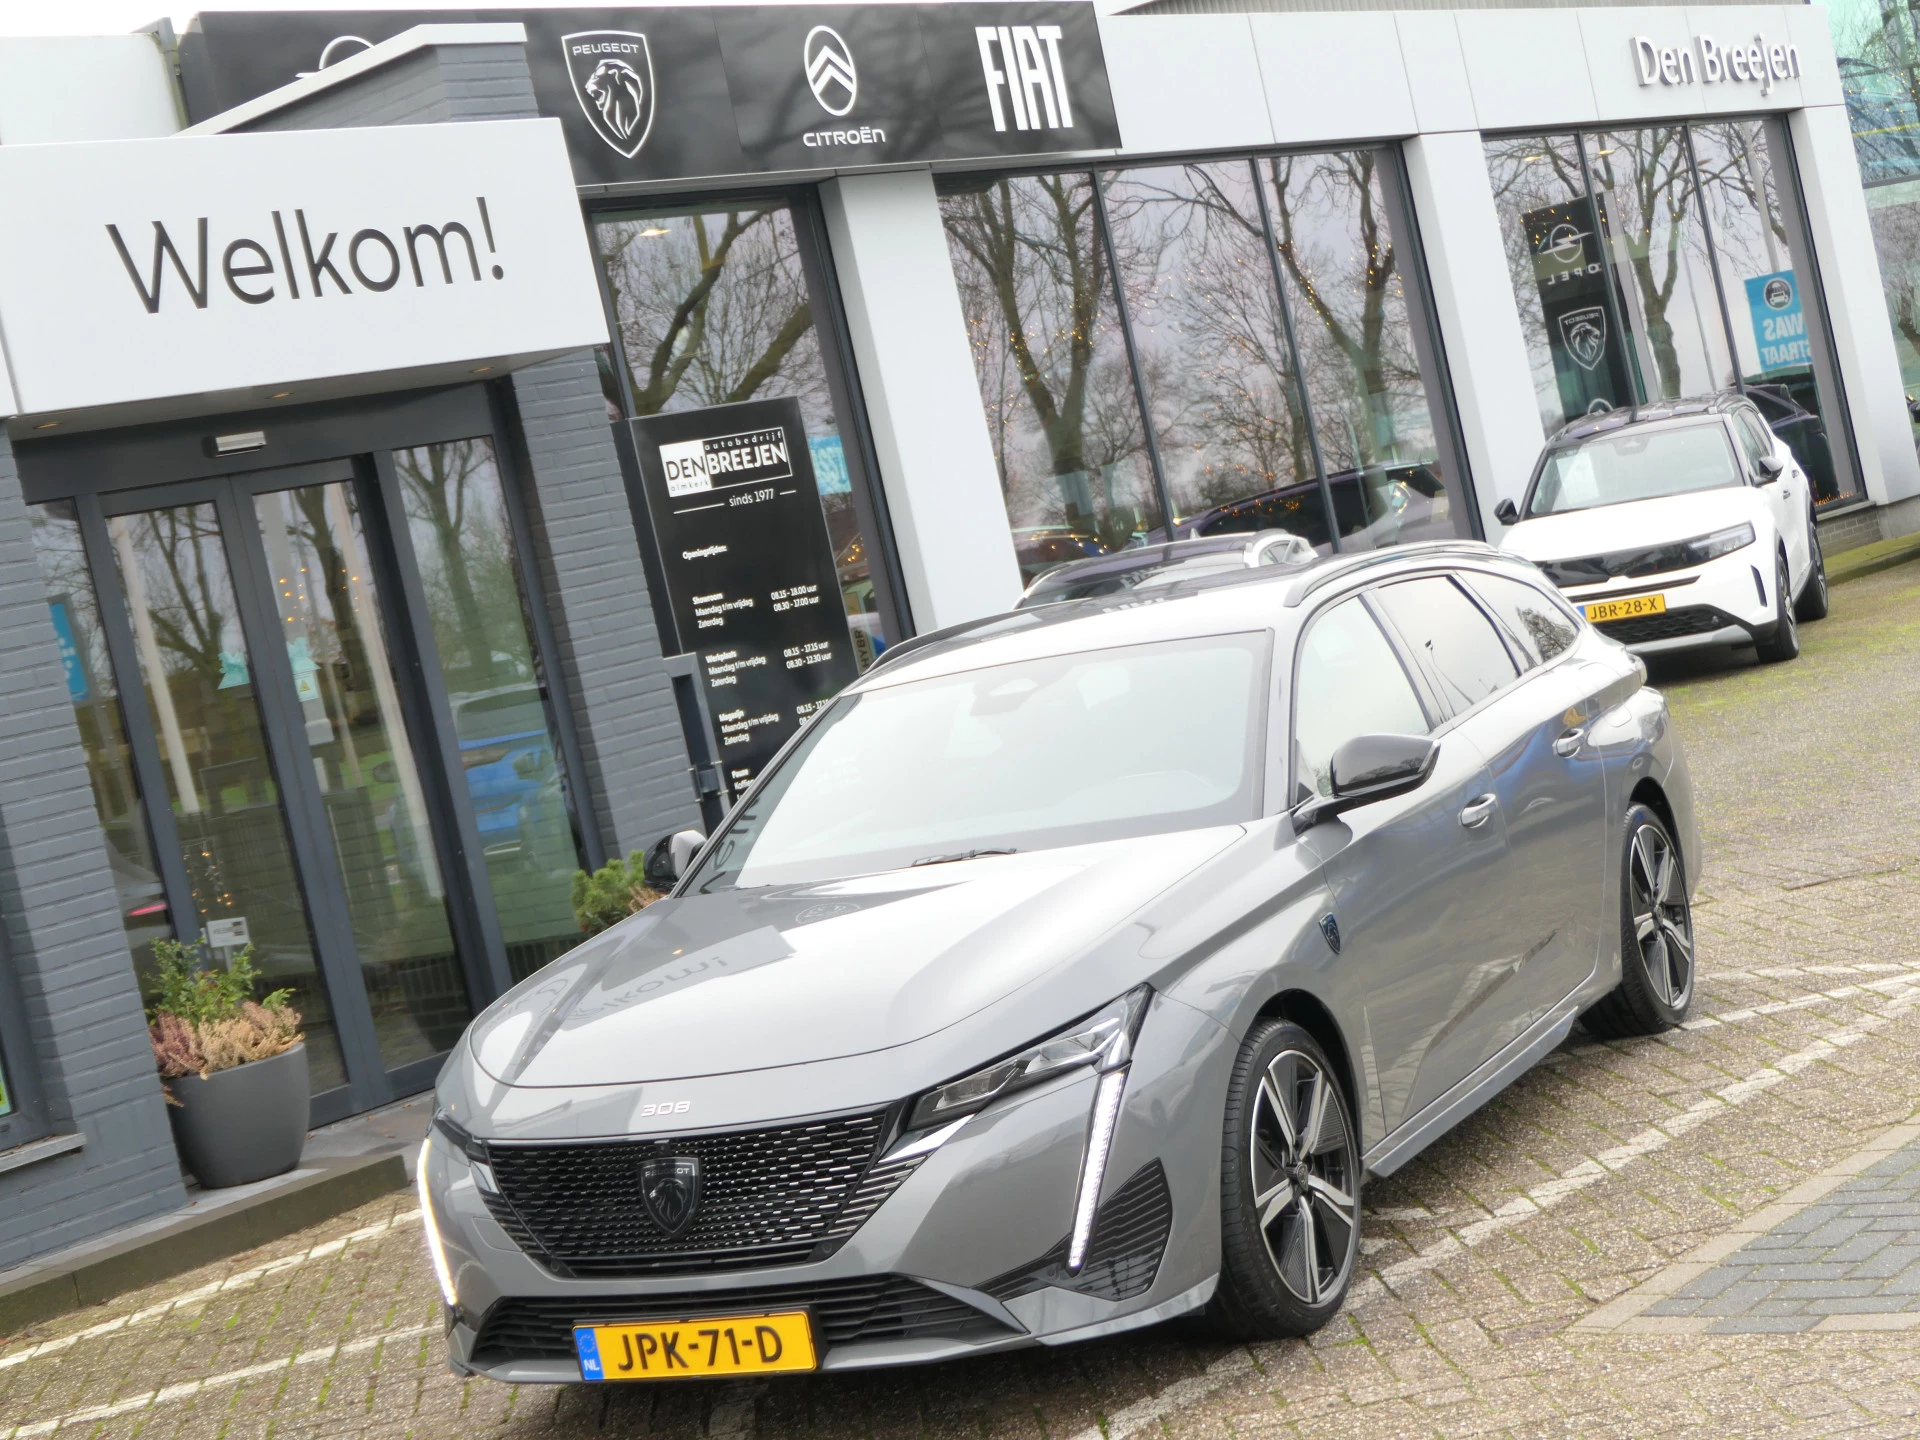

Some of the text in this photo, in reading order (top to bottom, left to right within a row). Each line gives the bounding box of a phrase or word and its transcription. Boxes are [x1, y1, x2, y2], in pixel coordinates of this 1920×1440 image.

[572, 43, 639, 56] PEUGEOT
[975, 25, 1074, 132] FIAT
[1629, 32, 1802, 97] Den Breejen
[104, 196, 504, 315] Welkom!
[704, 430, 781, 451] autobedrijf
[729, 488, 774, 507] sinds 1977
[695, 604, 722, 617] Maandag
[806, 584, 817, 592] uur
[697, 617, 724, 629] Zaterdag
[809, 596, 819, 604] uur
[1590, 597, 1658, 620] JBR-28-X
[708, 662, 735, 676] Maandag
[818, 641, 829, 649] uur
[710, 675, 737, 688] Zaterdag
[821, 652, 832, 660] uur
[721, 719, 749, 733] Maandag
[723, 733, 750, 746] Zaterdag
[641, 1101, 691, 1117] 308
[645, 1167, 690, 1178] PEUOT
[584, 1325, 783, 1372] NL JPK-71-D
